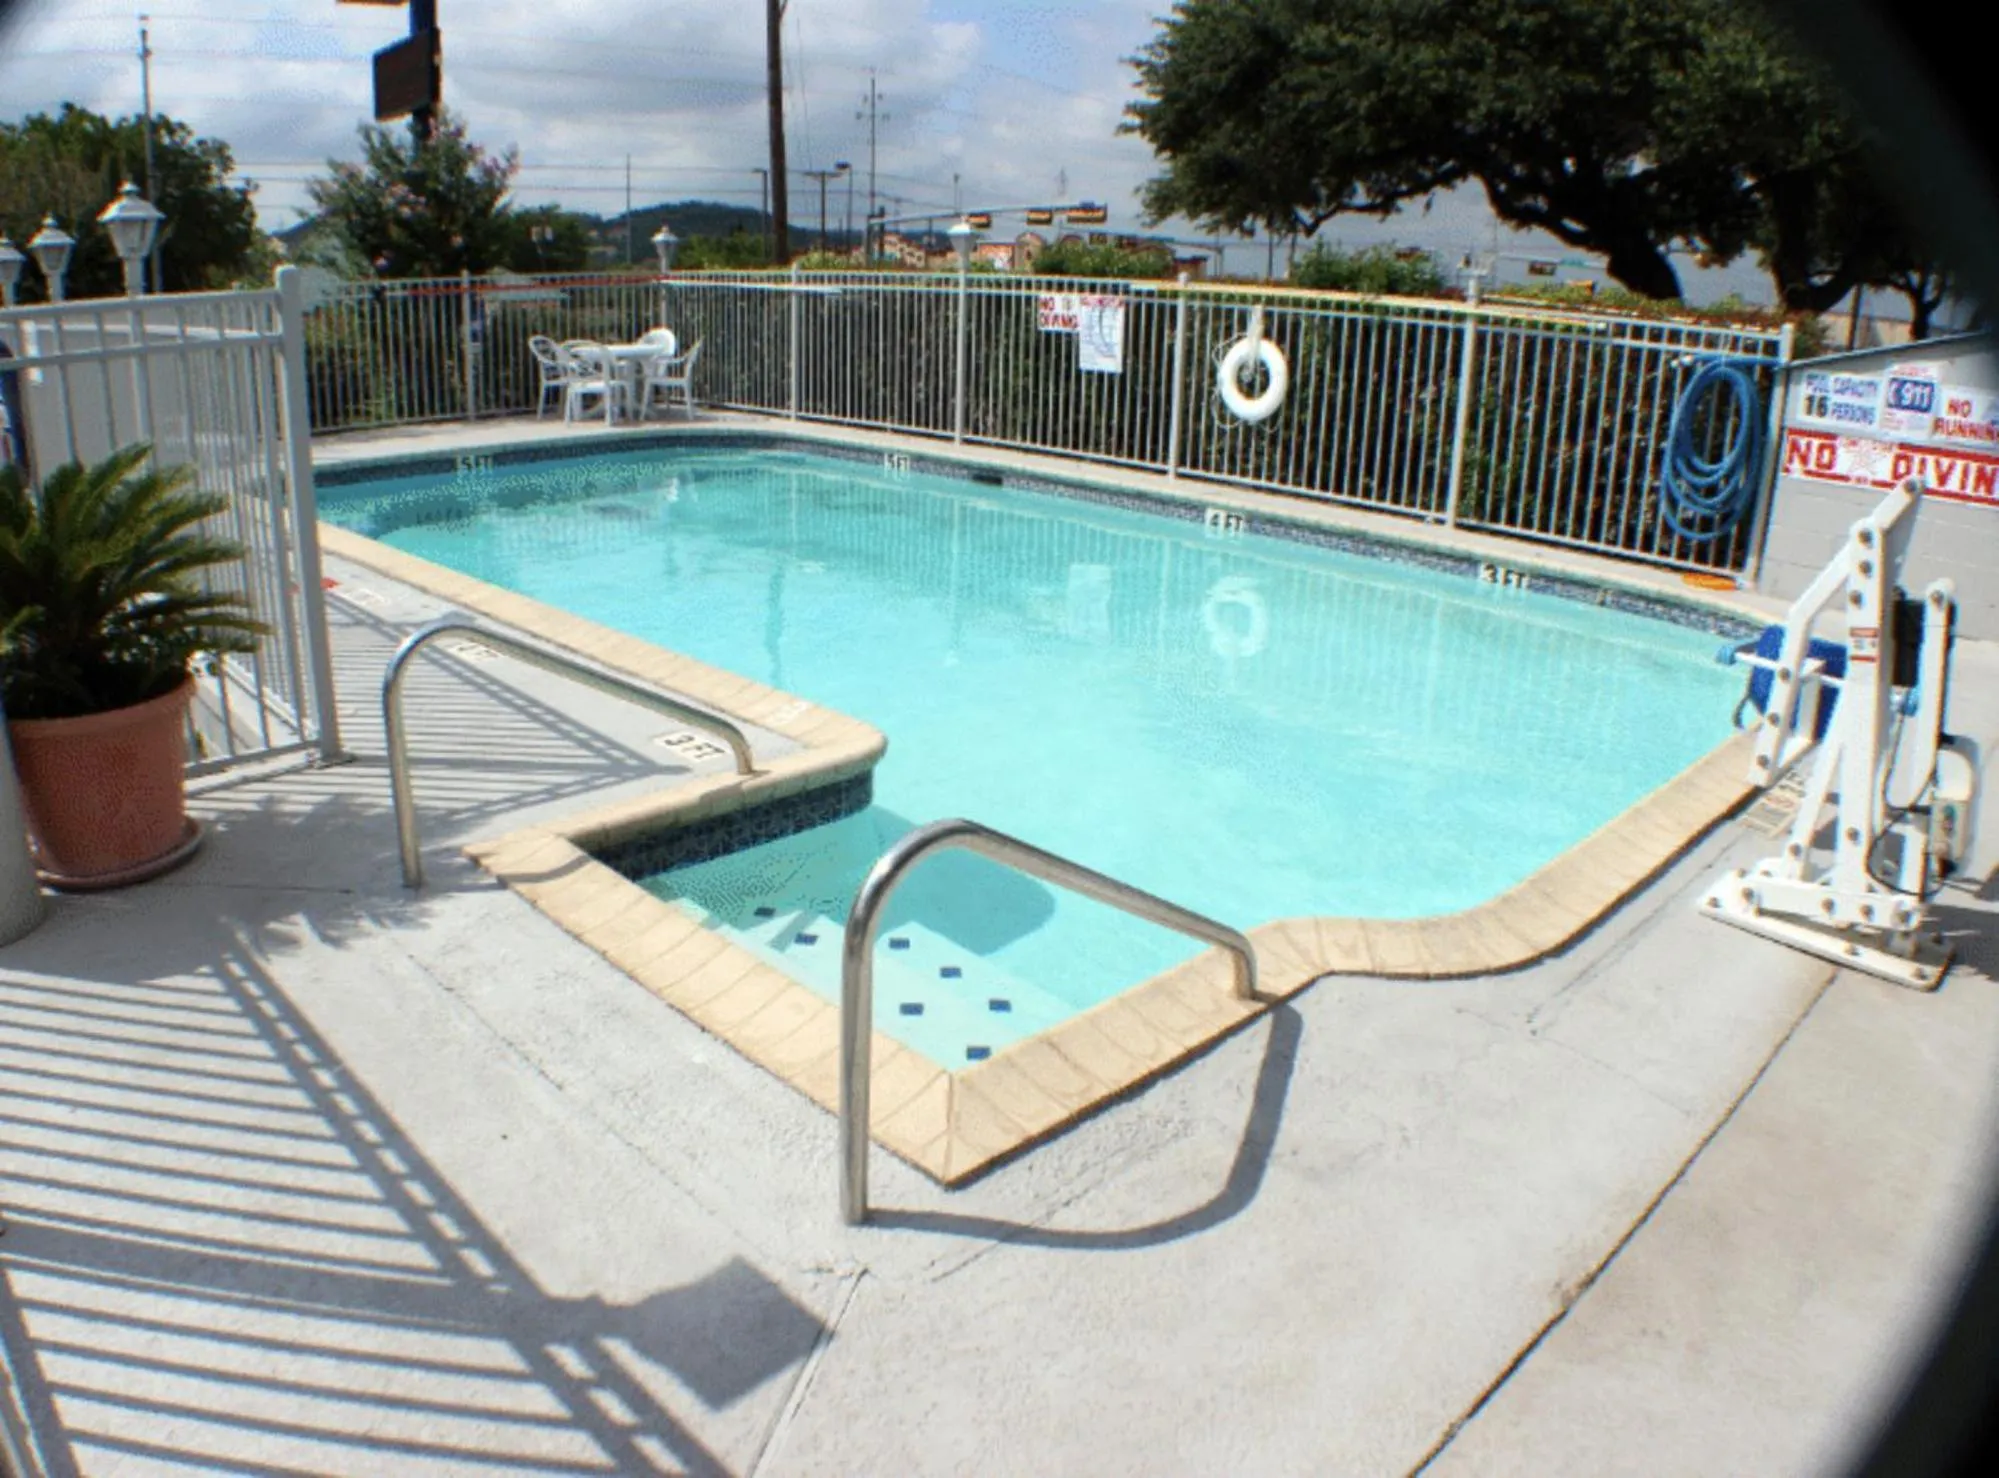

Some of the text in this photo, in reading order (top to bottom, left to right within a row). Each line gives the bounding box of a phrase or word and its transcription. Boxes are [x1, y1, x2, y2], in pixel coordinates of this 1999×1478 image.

[1901, 382, 1931, 411] 911
[1946, 397, 1972, 418] NO
[1786, 437, 1837, 471] NO
